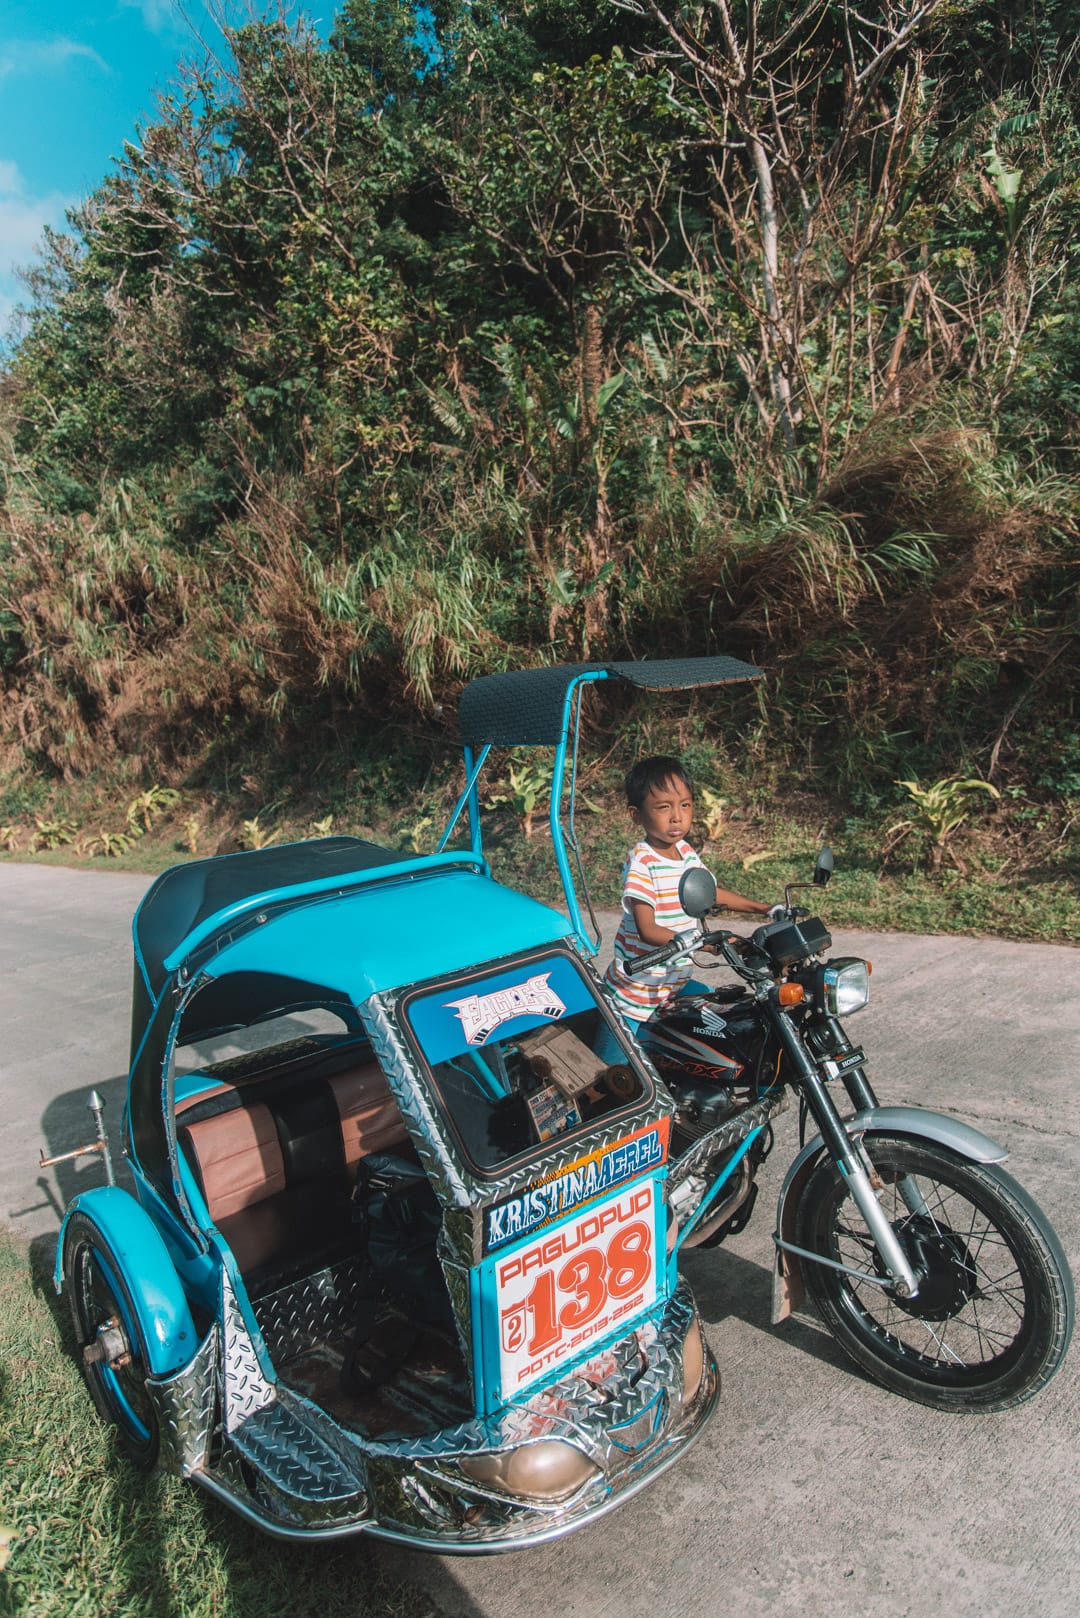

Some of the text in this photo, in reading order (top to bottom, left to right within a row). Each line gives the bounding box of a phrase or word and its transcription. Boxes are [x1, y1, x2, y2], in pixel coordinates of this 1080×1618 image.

[442, 972, 566, 1045] EAGLES
[692, 1026, 727, 1039] HONDA
[842, 1054, 862, 1068] HONDA
[500, 1188, 652, 1288] PAGUDPUD
[526, 1220, 651, 1357] 138
[508, 1315, 522, 1349] 2
